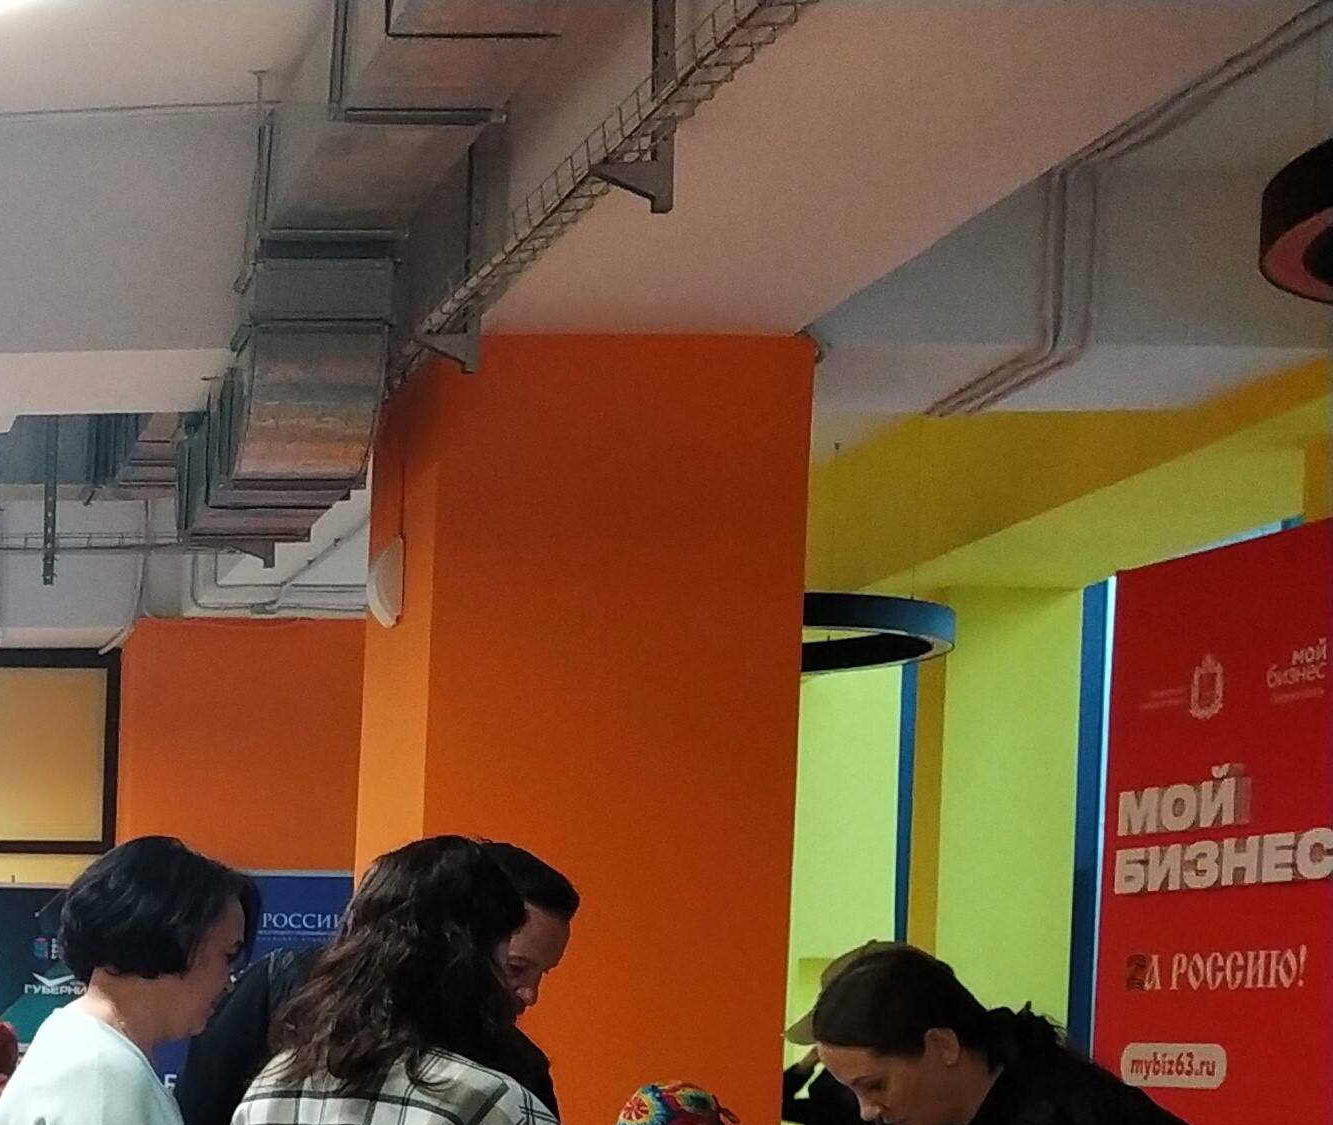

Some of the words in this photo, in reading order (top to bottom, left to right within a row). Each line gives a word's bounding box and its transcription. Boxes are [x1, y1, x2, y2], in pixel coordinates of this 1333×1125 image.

[1117, 763, 1236, 837] МОЙ
[1114, 828, 1333, 895] БИЗНЕС
[1169, 944, 1307, 991] РОССИЮ!
[1130, 1051, 1215, 1081] mybiz63.ru
